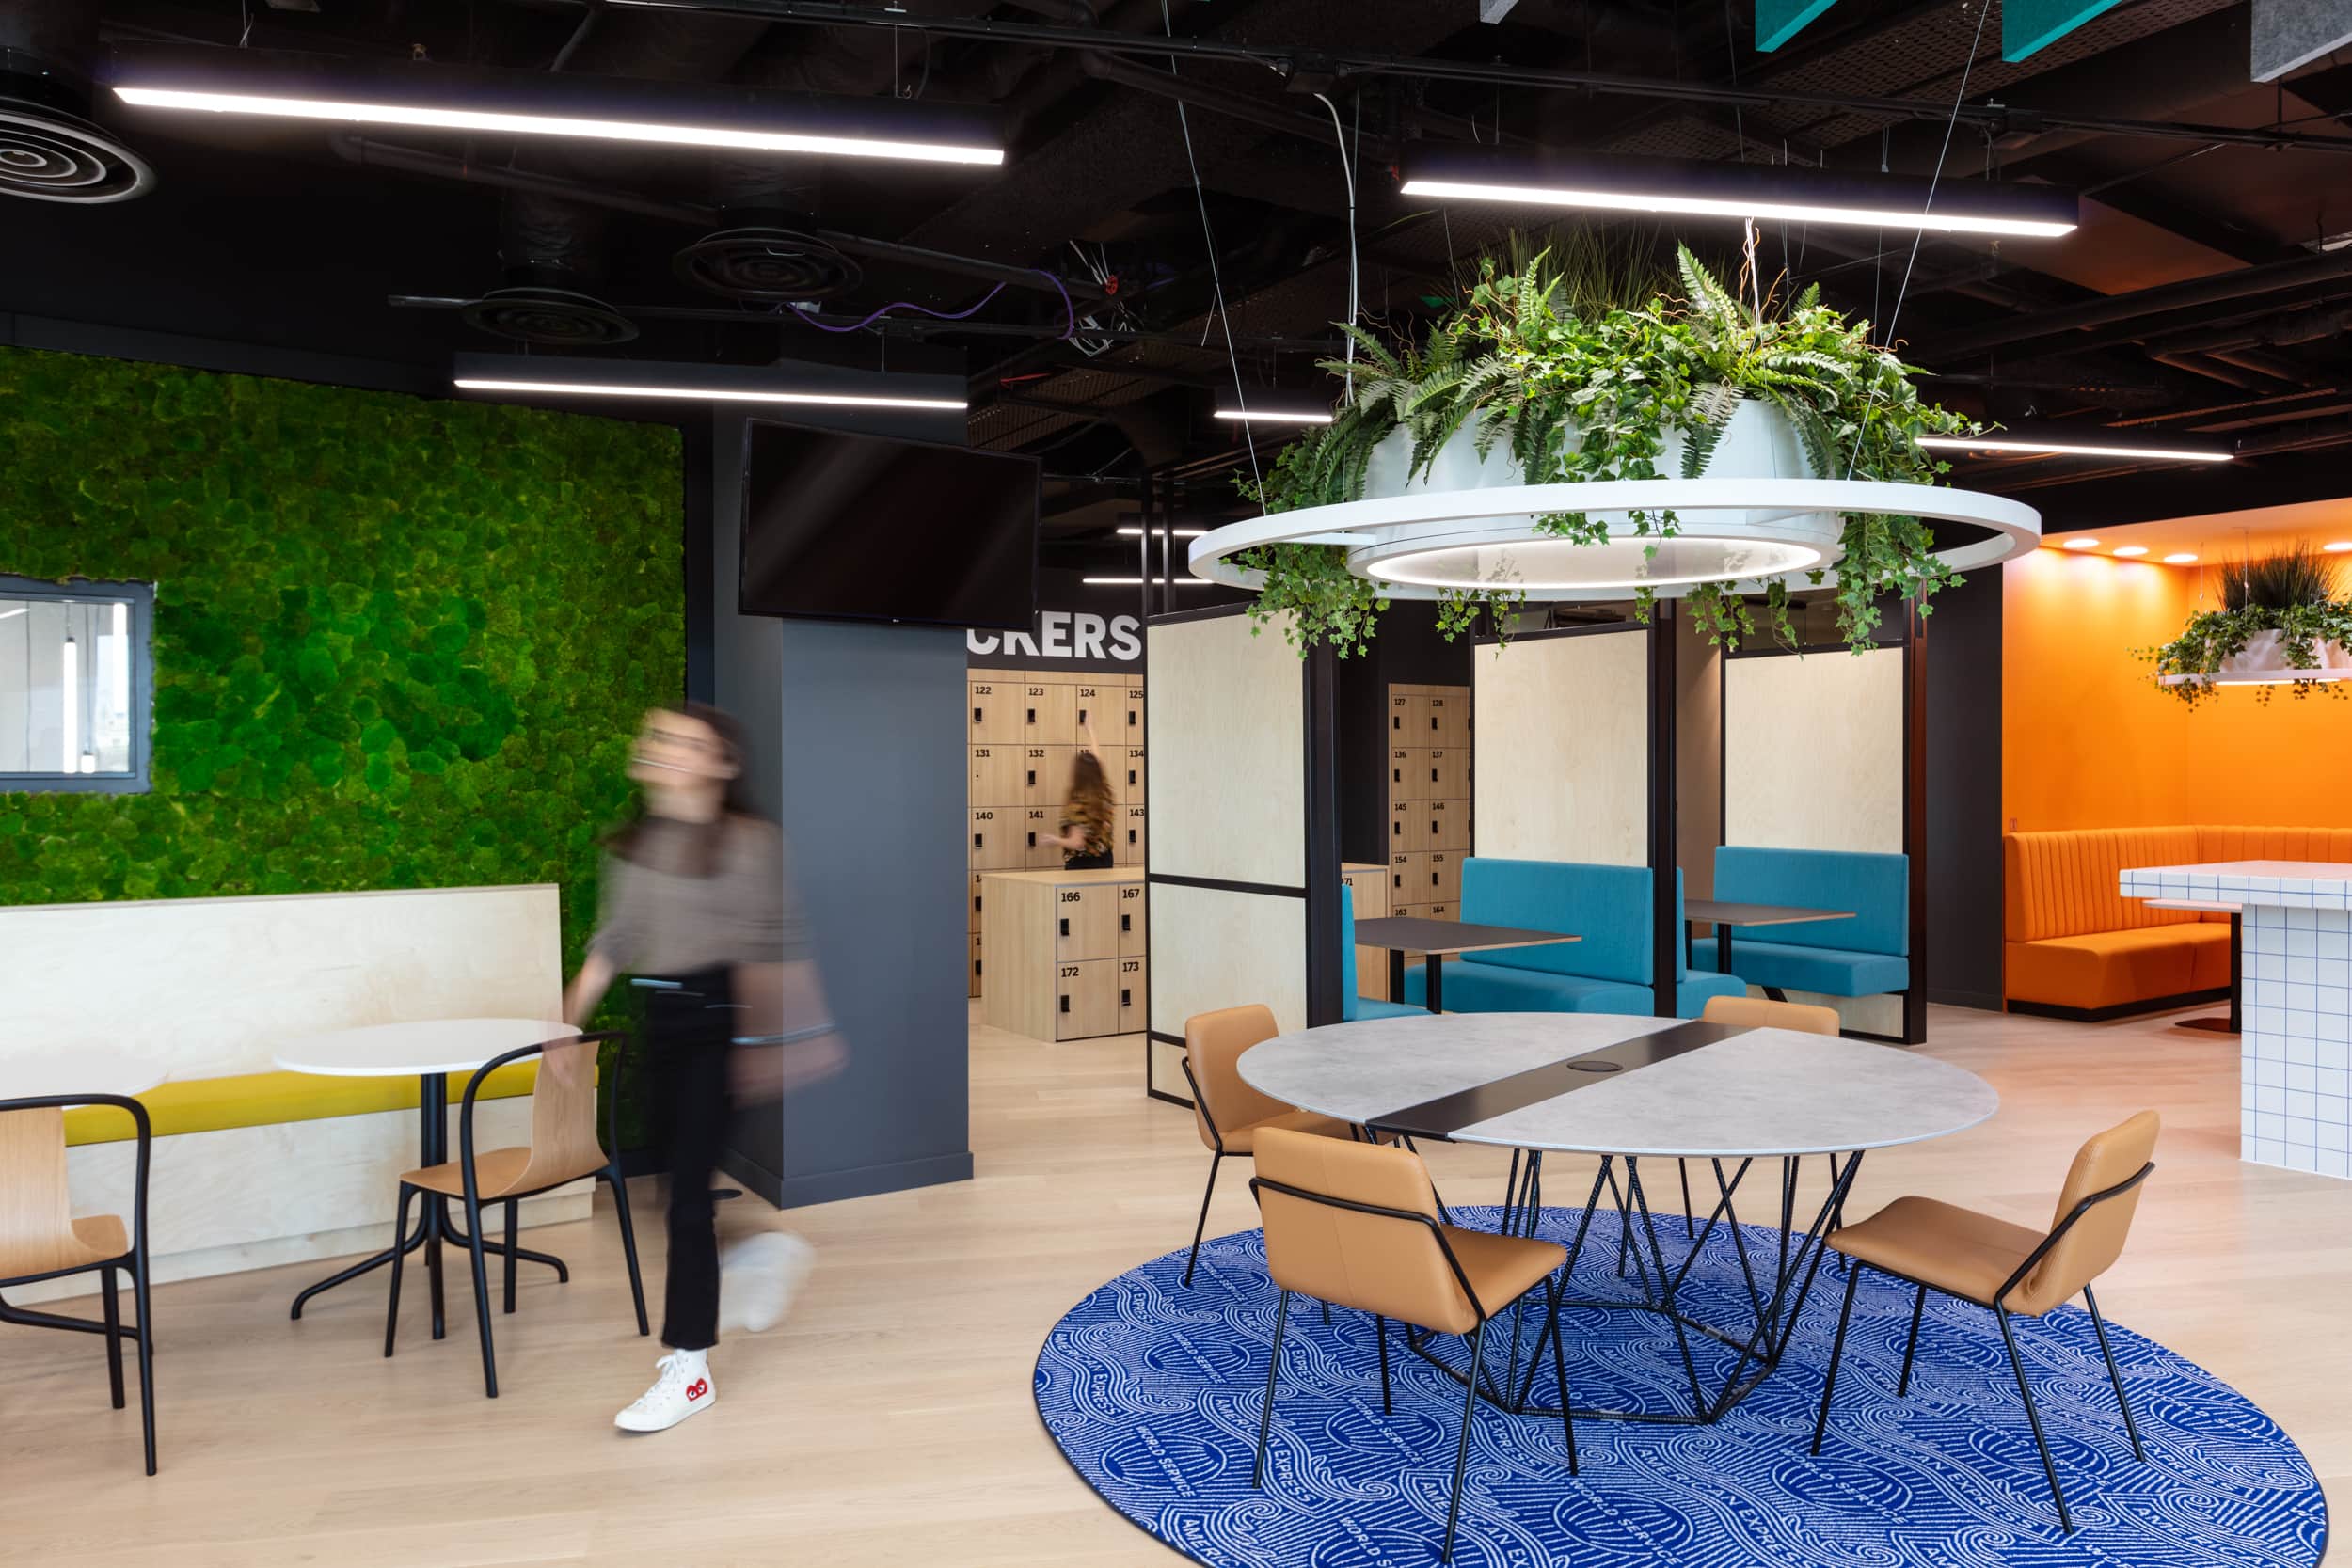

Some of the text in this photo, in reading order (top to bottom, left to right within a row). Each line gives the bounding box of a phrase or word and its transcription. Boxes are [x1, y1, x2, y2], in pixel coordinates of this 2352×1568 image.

[975, 687, 992, 695] 122
[1028, 688, 1044, 696] 123
[1080, 689, 1096, 698] 124
[1129, 690, 1144, 699] 125
[975, 750, 991, 758] 131
[1028, 750, 1045, 758] 132
[1129, 750, 1144, 758] 134
[975, 812, 993, 820] 140
[1029, 810, 1044, 819] 141
[1130, 809, 1145, 817] 143
[1060, 892, 1081, 903] 166
[1122, 889, 1140, 899] 167
[1060, 967, 1079, 978] 172
[1122, 961, 1139, 973] 173
[1133, 1292, 1158, 1324] EXPRESS
[1054, 1332, 1122, 1416] AMERICAN EXPRESS
[1172, 1331, 1228, 1385] WORLD SERVICE
[1292, 1348, 1330, 1388] EXPRESS
[1348, 1396, 1425, 1464] WORLD SERVICE
[1488, 1418, 1543, 1467] EXPRESS
[1136, 1425, 1197, 1498] WORLD SERVICE
[1274, 1449, 1317, 1503] EXPRESS
[1836, 1418, 2040, 1528] AMERICAN EXPRESS
[2140, 1440, 2240, 1492] EXPRESS
[1638, 1449, 1815, 1568] AMERICAN EXPRESS
[1836, 1481, 1910, 1525] SERVICE
[1339, 1516, 1382, 1556] WORLD
[1569, 1480, 1684, 1566] WORLD SERVICE
[2133, 1507, 2281, 1568] AMERICA
